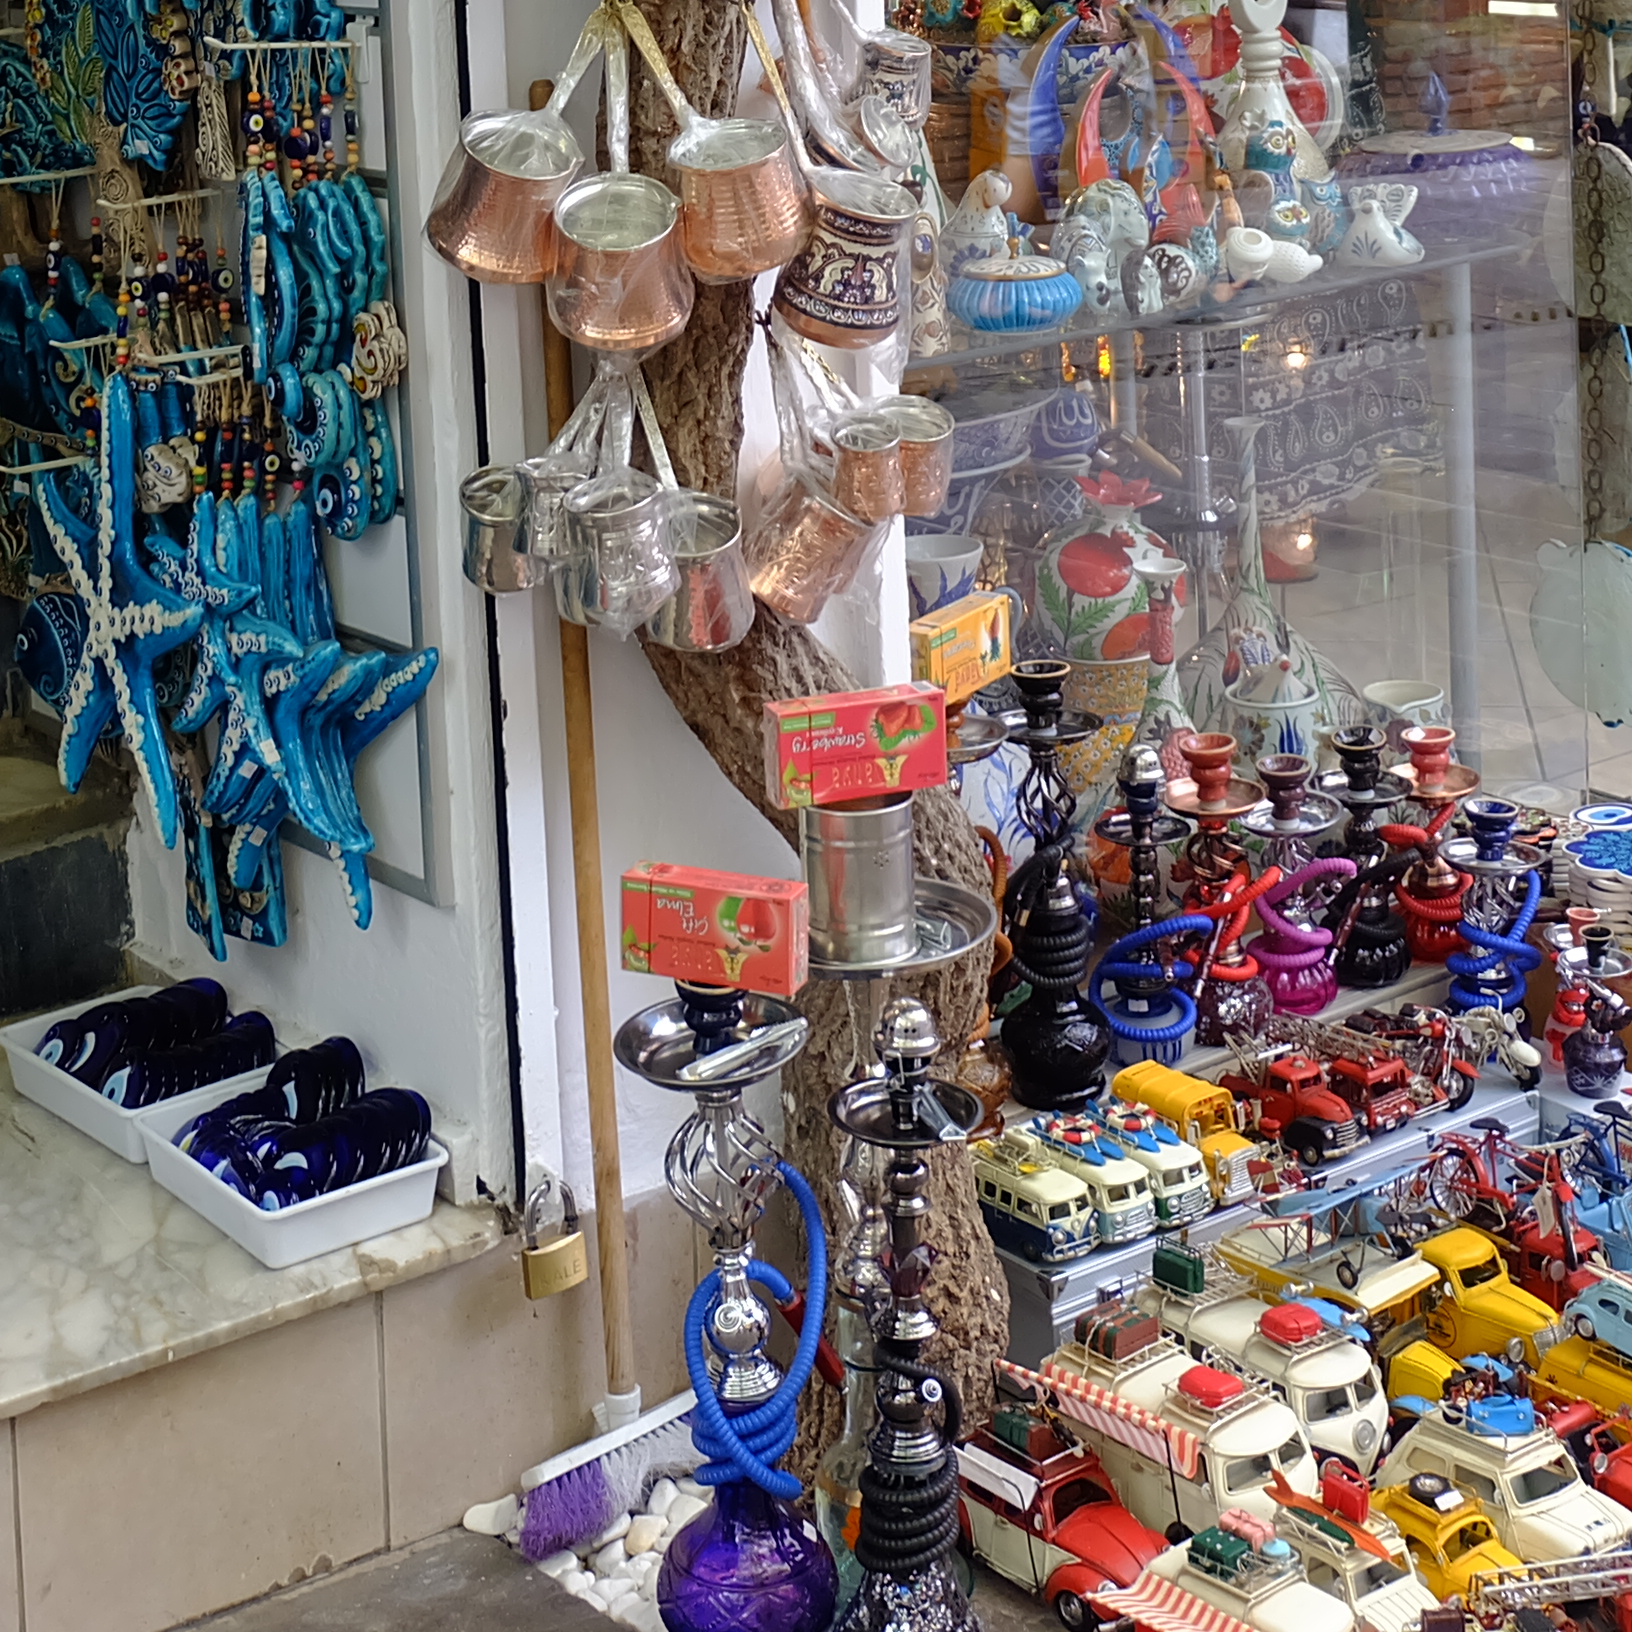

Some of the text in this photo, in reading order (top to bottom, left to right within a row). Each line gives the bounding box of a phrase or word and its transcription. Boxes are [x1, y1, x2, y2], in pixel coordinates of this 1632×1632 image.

[791, 732, 867, 754] Strawberry
[656, 897, 695, 918] Elma
[682, 915, 709, 936] Çift
